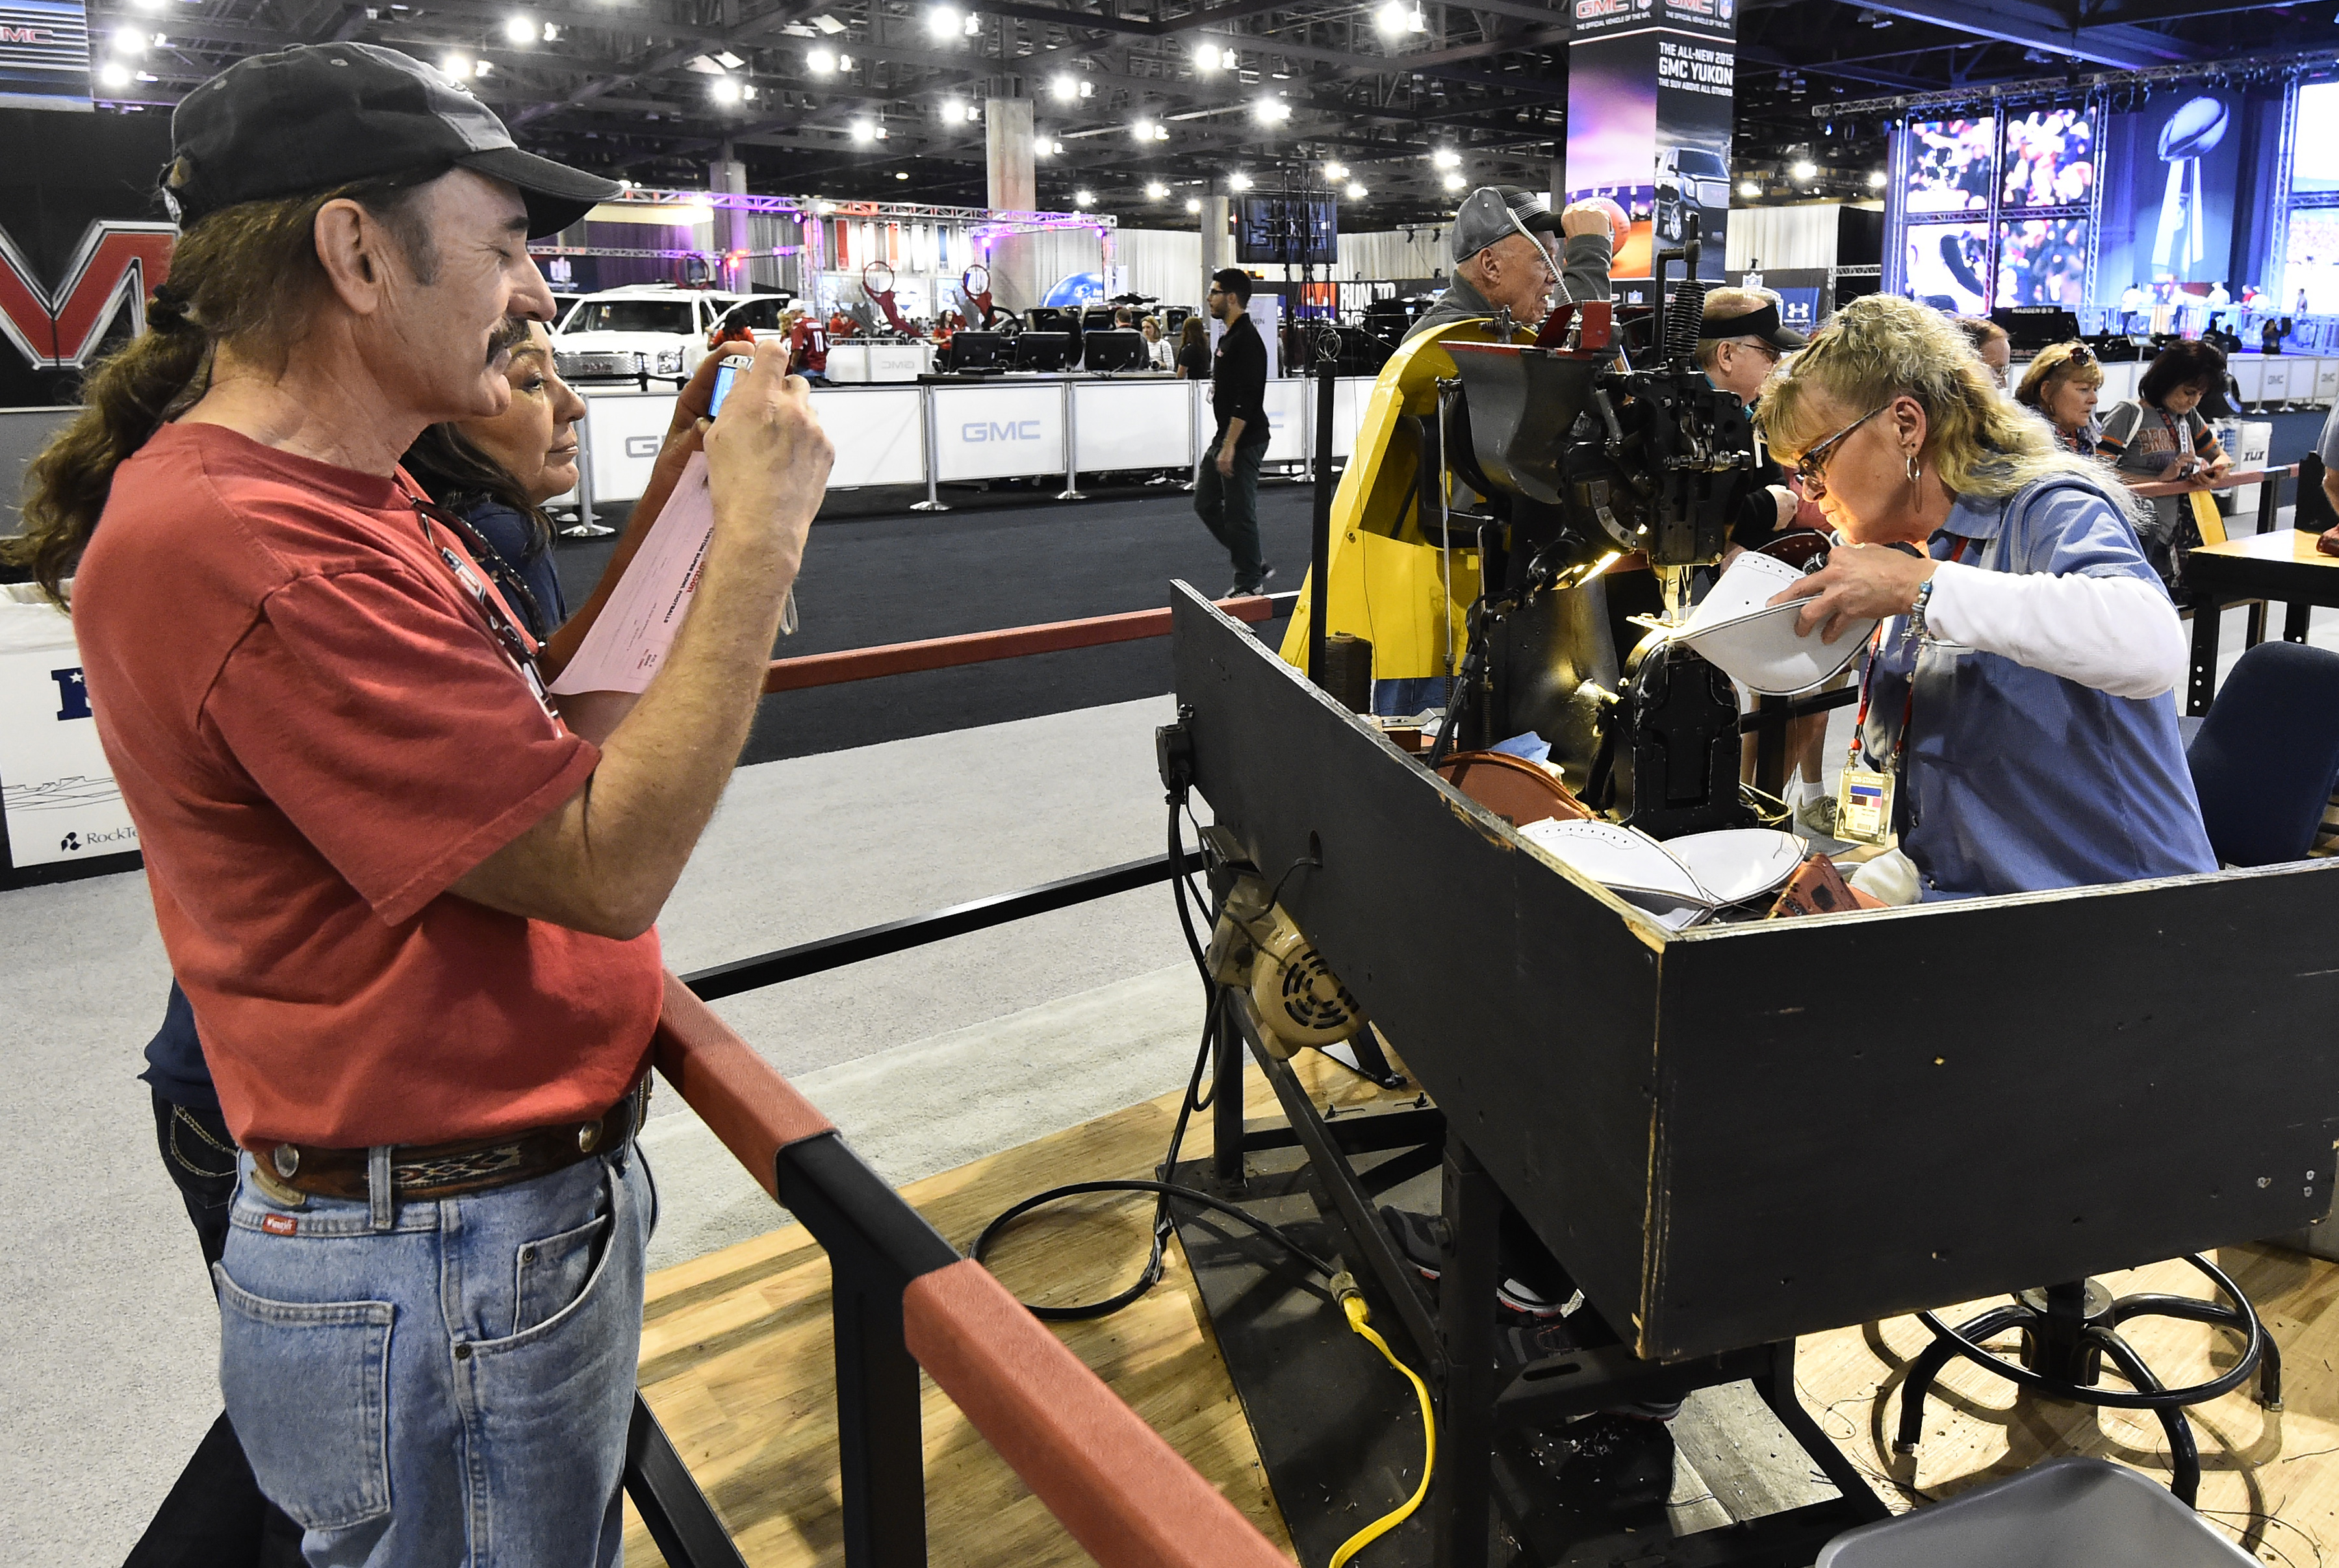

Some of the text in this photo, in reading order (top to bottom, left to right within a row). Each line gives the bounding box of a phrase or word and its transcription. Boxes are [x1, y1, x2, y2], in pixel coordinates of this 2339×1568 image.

[1576, 0, 1629, 19] GMC
[0, 26, 53, 44] MC
[1659, 42, 1734, 66] THE ALL-NEW 2015
[1659, 57, 1733, 86] GMC YUKON
[1658, 77, 1733, 97] THE SUV ABOVE ALL OTHERS
[1339, 283, 1372, 310] RUN
[962, 420, 1041, 442] GMC
[663, 527, 715, 623] CUSTOM SUPER BOWL FOOTBALLS
